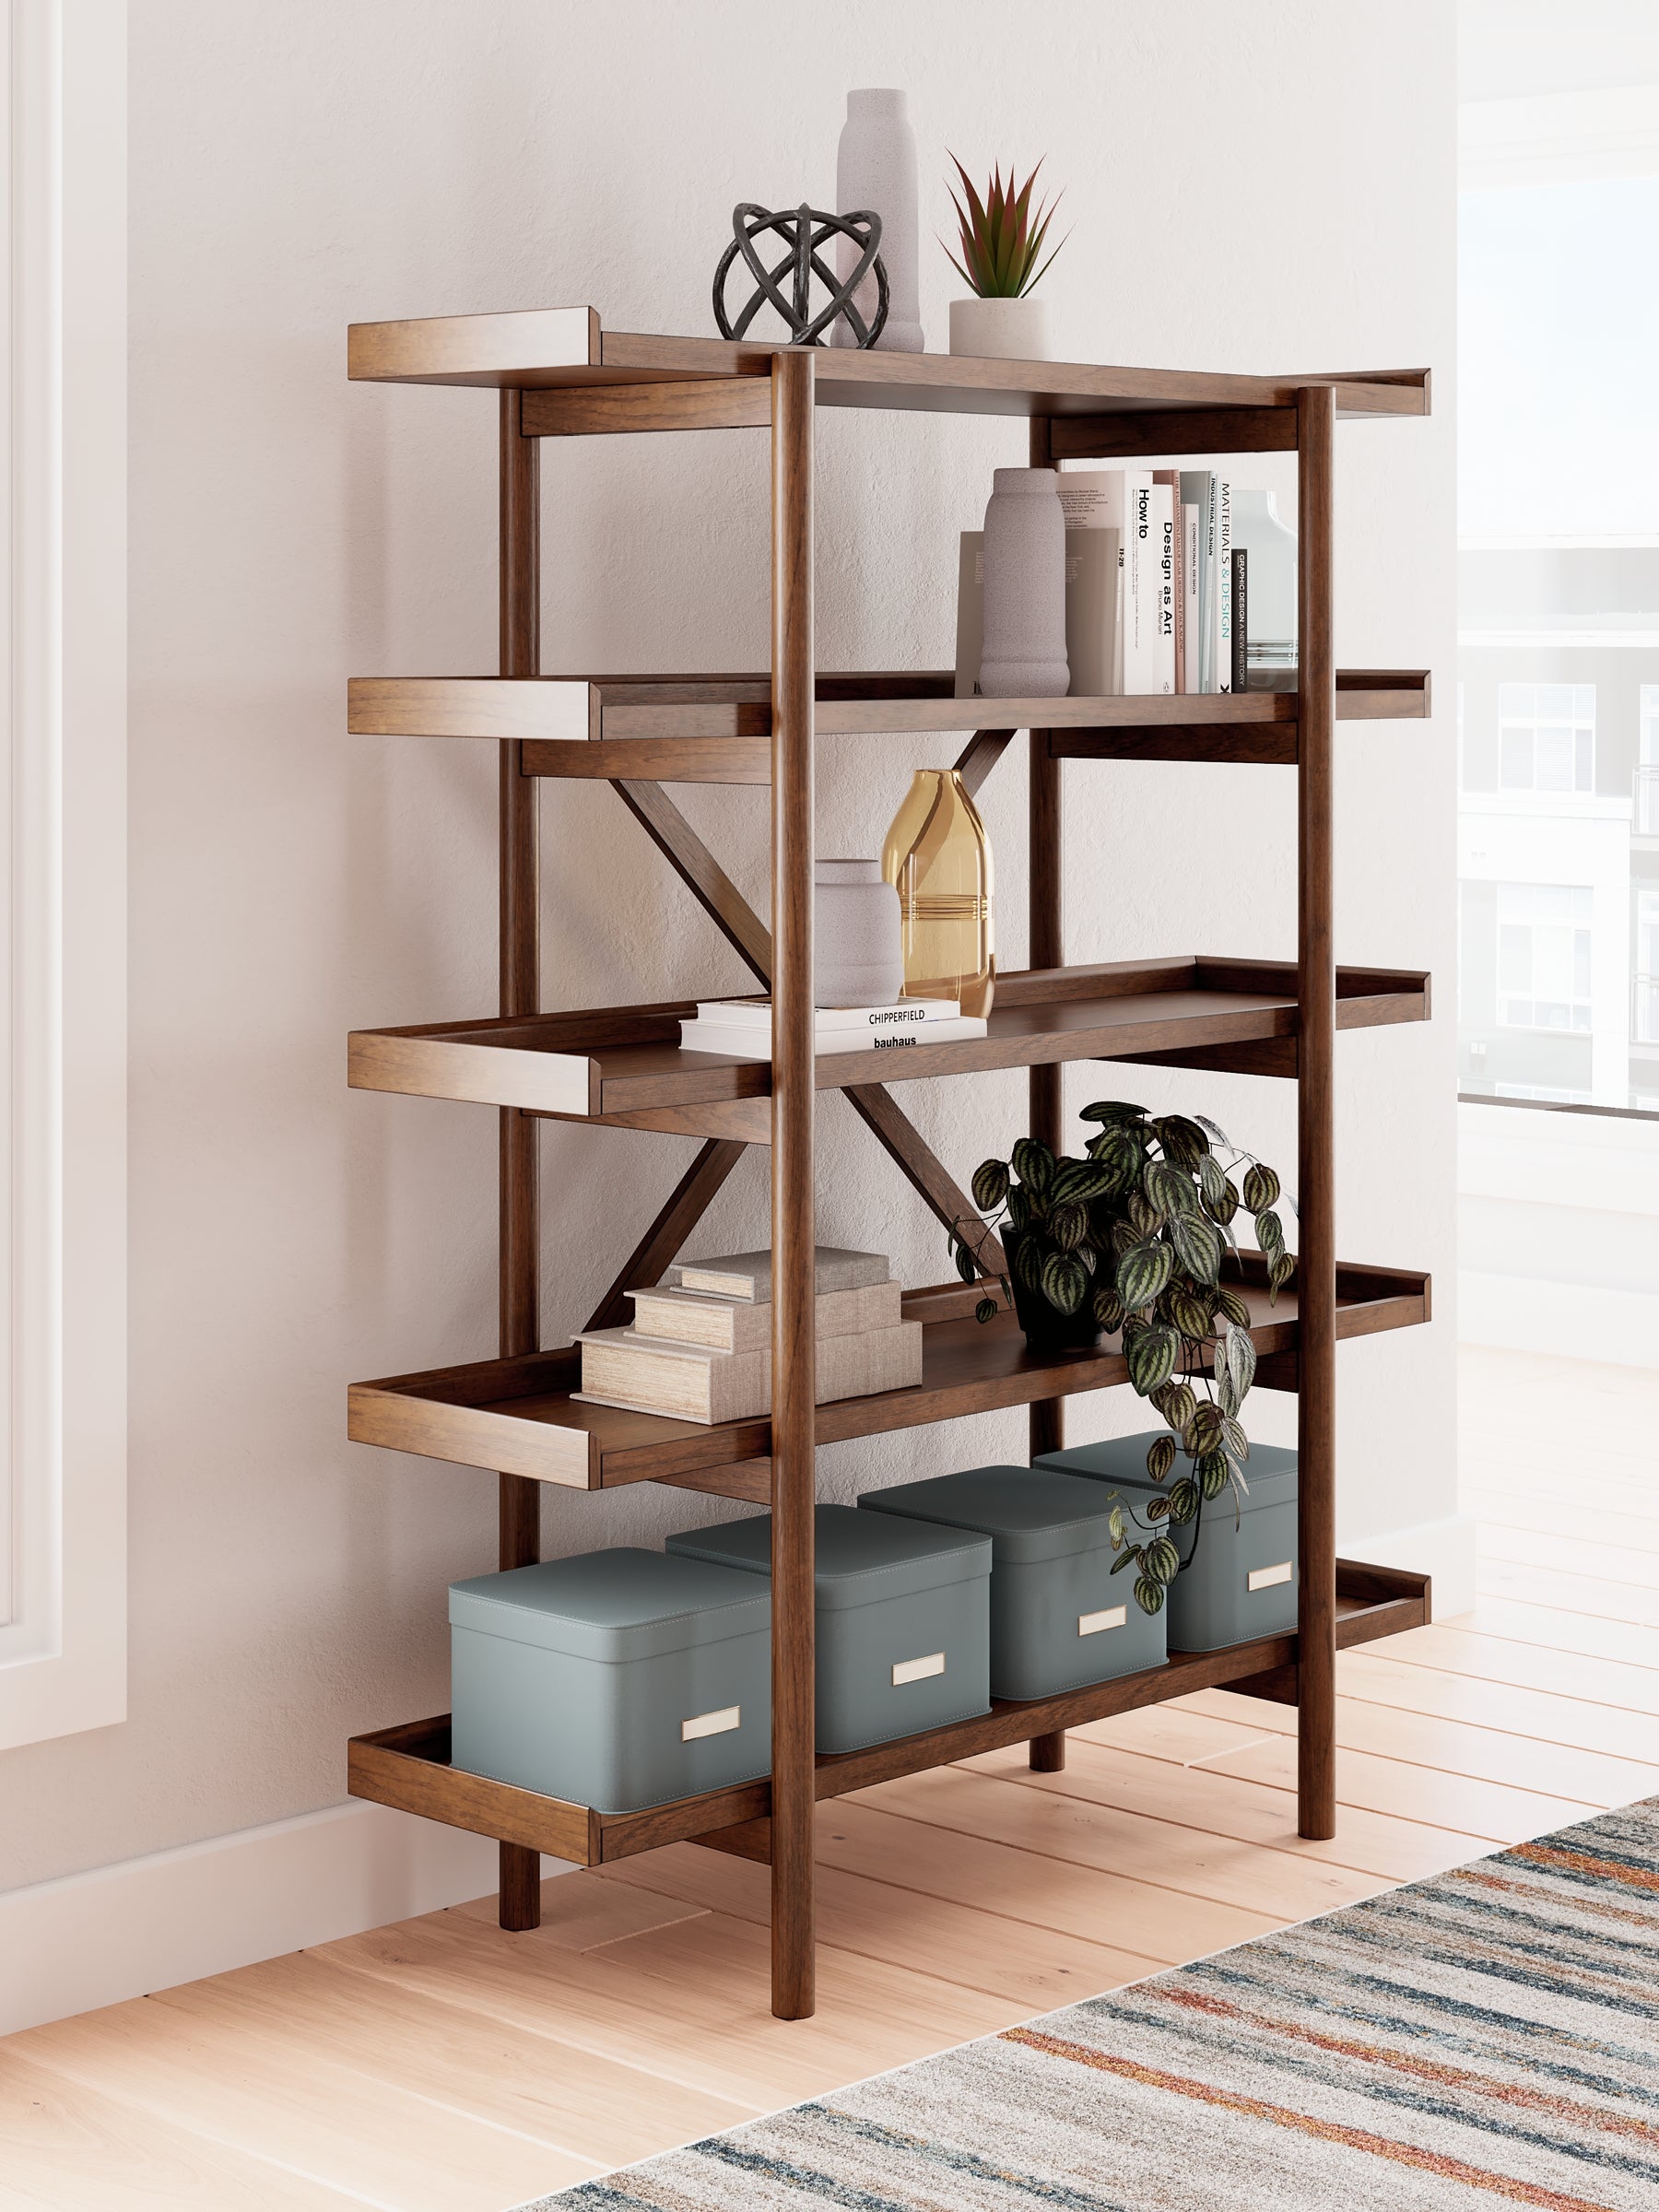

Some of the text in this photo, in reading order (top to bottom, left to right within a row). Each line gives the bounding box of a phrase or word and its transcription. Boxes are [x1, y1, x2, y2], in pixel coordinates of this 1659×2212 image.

[1139, 489, 1149, 538] How to
[1161, 523, 1172, 635] Design as Art
[1221, 483, 1230, 639] MATERIALS & DESIGN
[869, 1009, 924, 1024] CHIPPERFIELD
[874, 1036, 916, 1048] bauhaus
